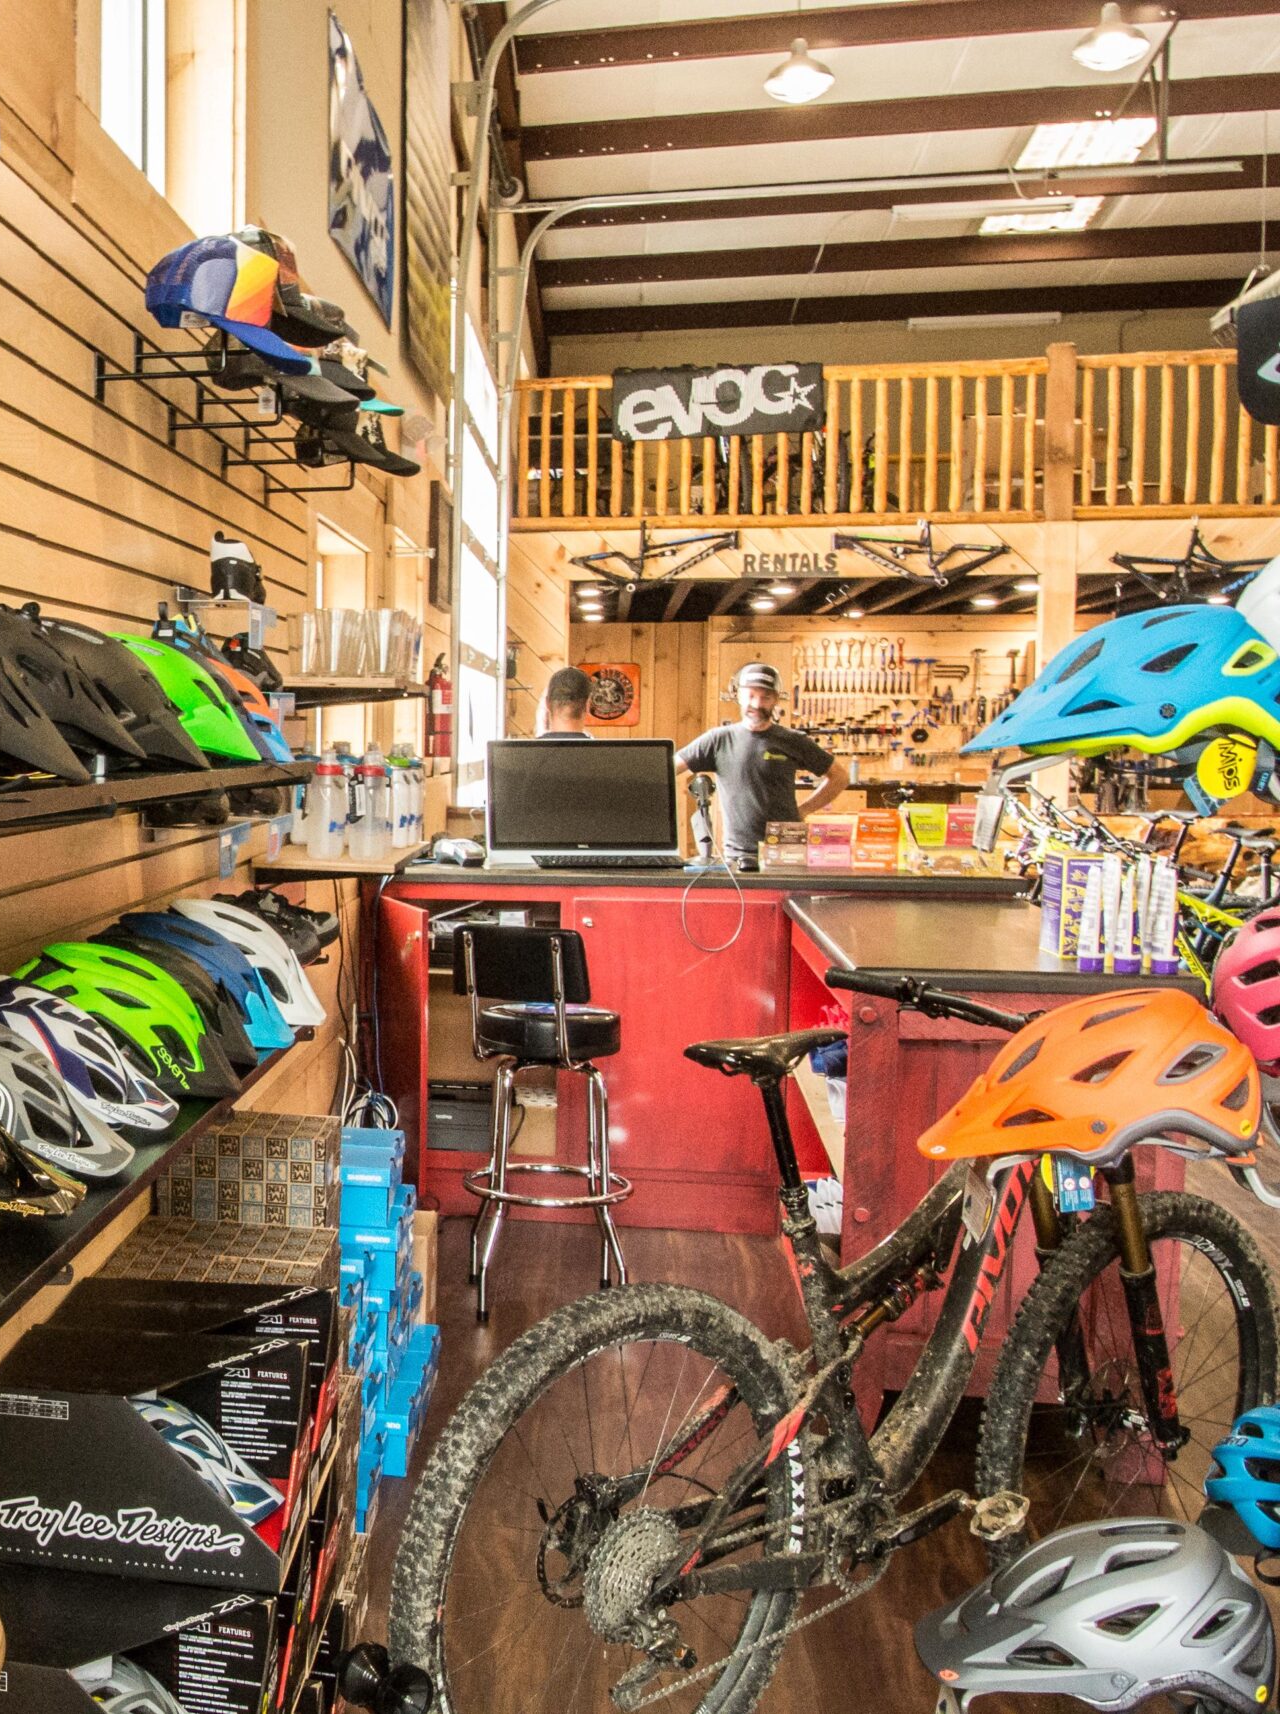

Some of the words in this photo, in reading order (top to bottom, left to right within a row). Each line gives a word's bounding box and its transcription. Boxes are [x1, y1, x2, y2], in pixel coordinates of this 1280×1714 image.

[743, 552, 838, 574] RENTALS
[288, 1316, 317, 1325] FEATURES
[257, 1370, 288, 1380] FEATURES
[787, 1438, 805, 1555] MAXXIS
[60, 1501, 115, 1540] Lee
[116, 1507, 245, 1561] Designs
[125, 1560, 183, 1570] FASTEST
[194, 1567, 244, 1578] RACERS
[218, 1626, 251, 1638] FEATURES
